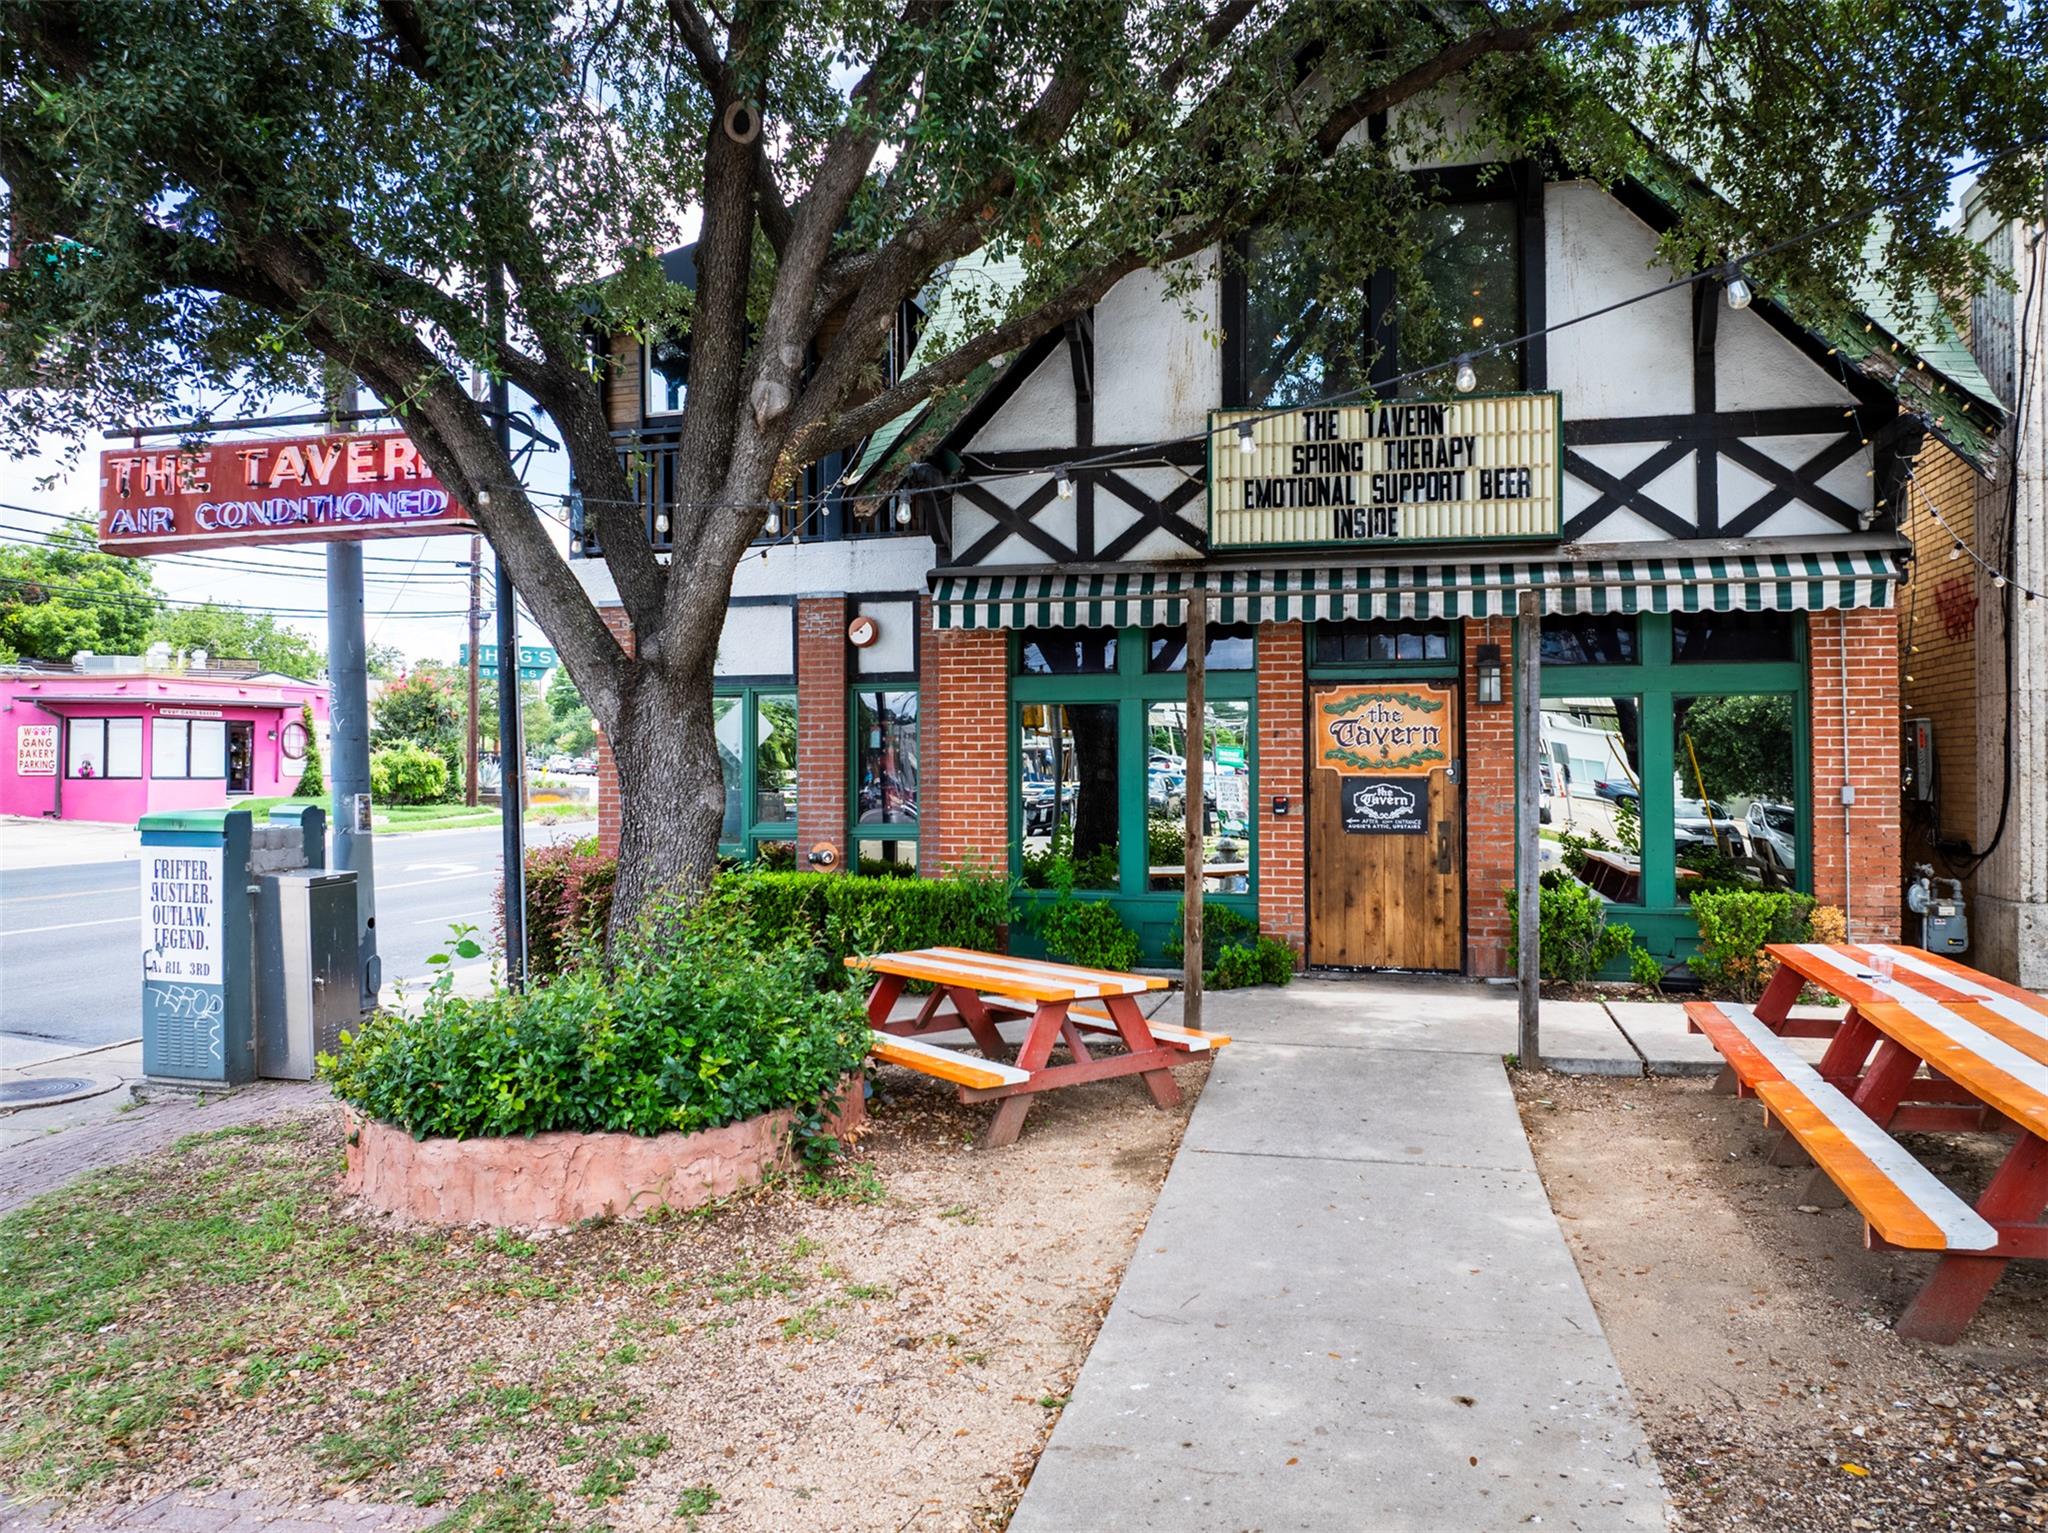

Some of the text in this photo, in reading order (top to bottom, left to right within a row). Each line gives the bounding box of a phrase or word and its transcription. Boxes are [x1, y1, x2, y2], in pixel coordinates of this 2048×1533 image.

[1302, 405, 1445, 441] THE TAVERN
[1292, 436, 1476, 475] SPRING THERAPY
[107, 452, 212, 498] THE
[1244, 467, 1531, 510] EMOTIONAL SUPPORT BEER
[108, 489, 449, 534] AIR CONDITIONED
[1333, 507, 1399, 539] INSIDE
[482, 668, 537, 679] BALS
[1368, 703, 1402, 723] the
[1329, 715, 1441, 747] Tavern
[22, 738, 53, 748] GANG
[19, 749, 55, 759] BAKERY
[19, 760, 55, 769] PARKING
[1360, 792, 1409, 807] Tavern
[1377, 786, 1394, 797] the
[152, 904, 210, 927] OUTLAW.
[151, 960, 210, 977] ARIL 3RD
